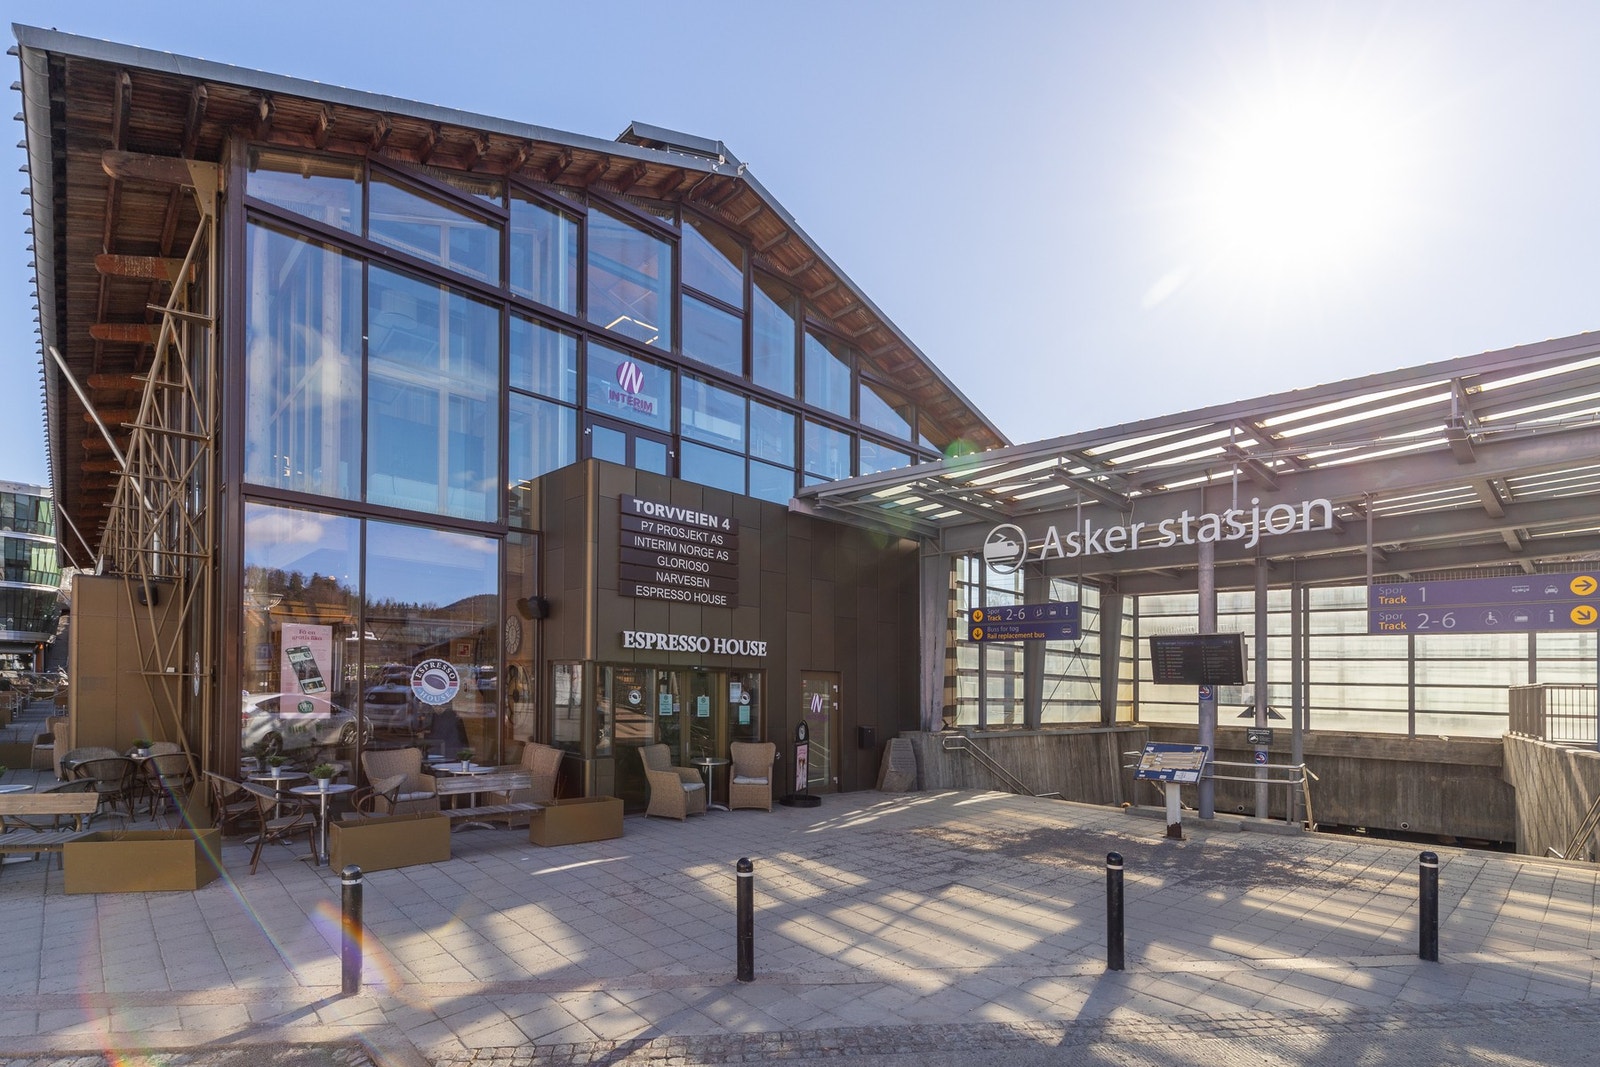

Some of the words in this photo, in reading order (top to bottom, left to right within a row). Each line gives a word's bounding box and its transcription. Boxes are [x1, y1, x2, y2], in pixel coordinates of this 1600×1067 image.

[609, 389, 653, 411] INTERIM
[633, 499, 718, 528] TORVVEIEN
[721, 518, 731, 531] 4
[641, 520, 654, 532] P7
[656, 523, 709, 543] PROSJEKT
[711, 534, 724, 545] AS
[1039, 519, 1145, 560] Asker
[1158, 497, 1333, 549] stasjon
[634, 535, 677, 553] INTERIM
[679, 543, 714, 559] NORGE
[716, 550, 729, 561] AS
[657, 555, 709, 573] GLORIOSO
[656, 571, 710, 588] NARVESEN
[635, 585, 691, 602] ESPRESSO
[693, 592, 727, 606] HOUSE
[1378, 586, 1403, 597] Spor
[1418, 587, 1426, 602] 1
[1378, 595, 1407, 605] Track
[1006, 608, 1026, 621] 2-6
[1378, 612, 1403, 622] Spor
[1417, 612, 1456, 629] 2-6
[1378, 620, 1407, 630] Track
[622, 630, 710, 653] ESPRESSO
[713, 637, 768, 657] HOUSE
[415, 661, 456, 680] ESPRESSO
[420, 690, 452, 702] HOUSE
